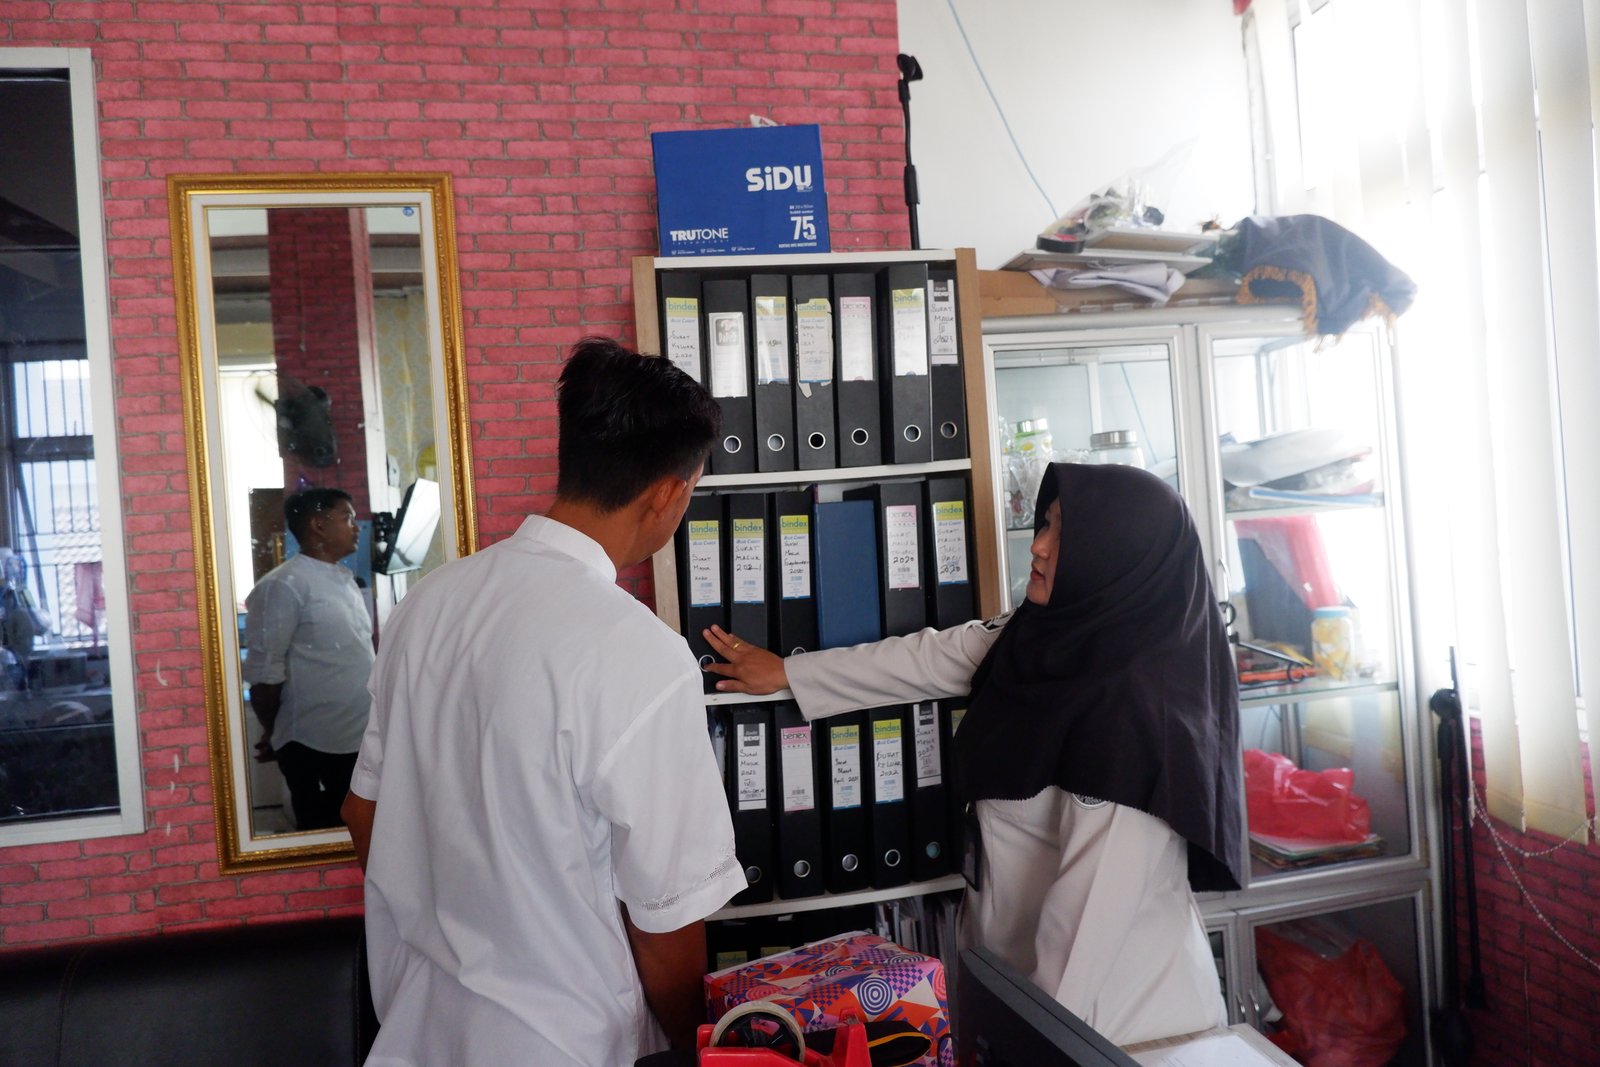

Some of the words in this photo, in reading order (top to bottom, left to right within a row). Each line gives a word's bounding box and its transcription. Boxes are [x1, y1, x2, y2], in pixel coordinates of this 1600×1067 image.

[745, 165, 811, 192] SiDU
[790, 215, 816, 240] 75
[670, 228, 728, 241] TRUTONE
[936, 504, 962, 514] bindex
[690, 522, 718, 533] bindex
[735, 522, 762, 532] bindex
[782, 518, 807, 528] bindex
[875, 722, 900, 732] bindex
[832, 728, 857, 738] bindex
